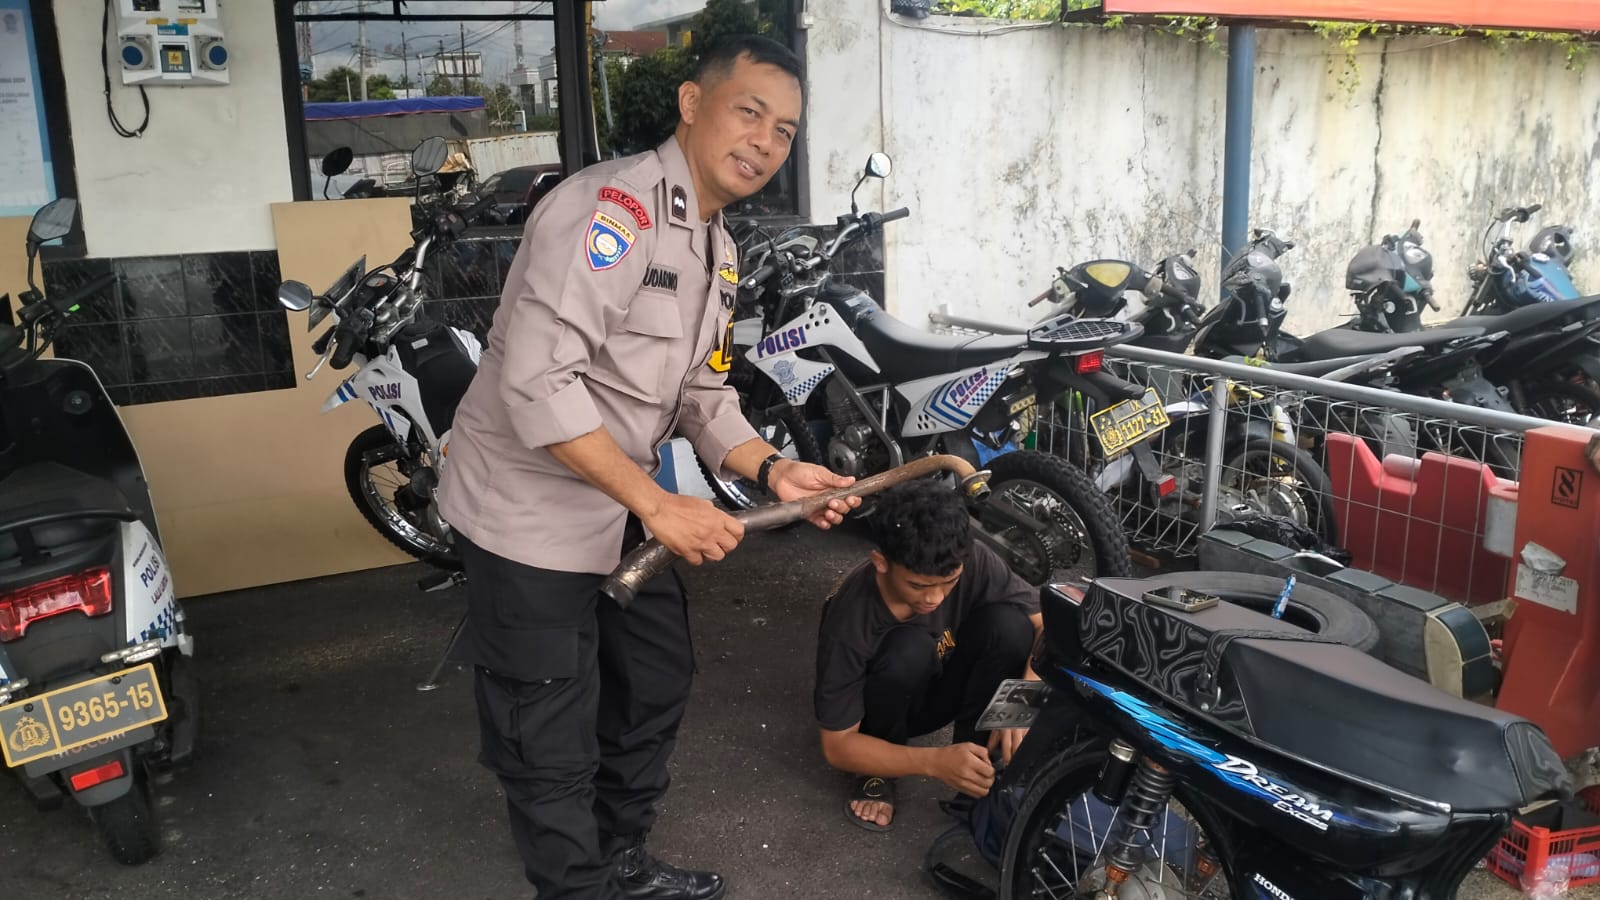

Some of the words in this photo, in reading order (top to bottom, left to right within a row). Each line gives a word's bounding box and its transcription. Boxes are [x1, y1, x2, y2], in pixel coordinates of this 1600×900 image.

[604, 189, 649, 225] PELOPOR
[600, 215, 631, 238] BINMAS
[756, 326, 807, 359] POLISI
[368, 382, 402, 400] POLISI
[949, 367, 987, 404] POLISI
[1122, 406, 1166, 440] 1127-31
[58, 682, 153, 732] 9365-15
[1211, 753, 1333, 821] DREAM
[1253, 872, 1295, 900] HOND
